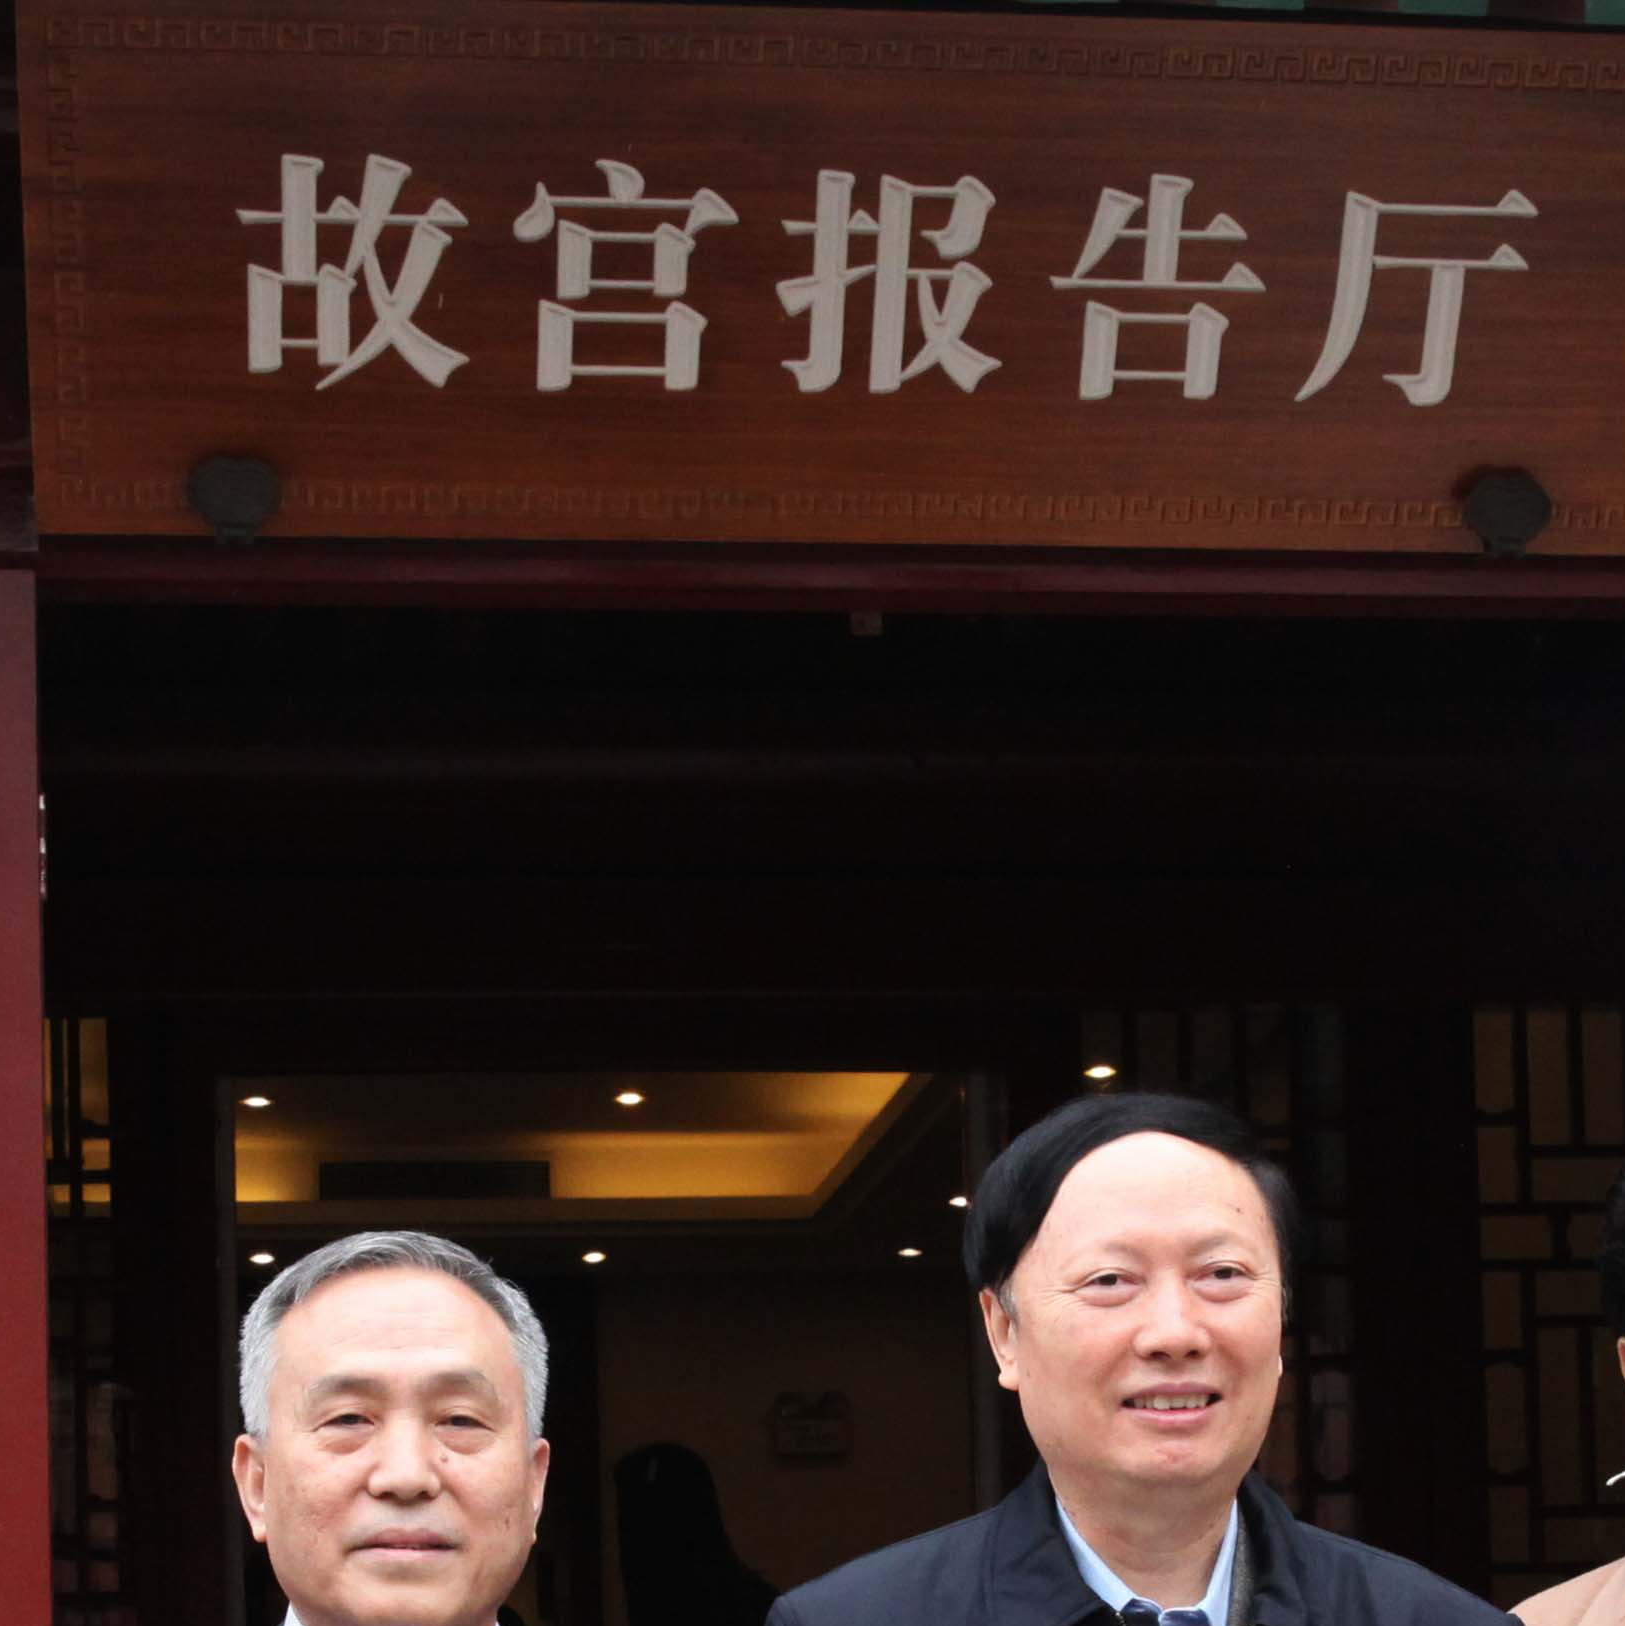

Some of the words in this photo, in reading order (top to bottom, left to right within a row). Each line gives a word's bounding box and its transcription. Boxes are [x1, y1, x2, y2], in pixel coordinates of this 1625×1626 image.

[236, 153, 1539, 407] 故宫报告厅
